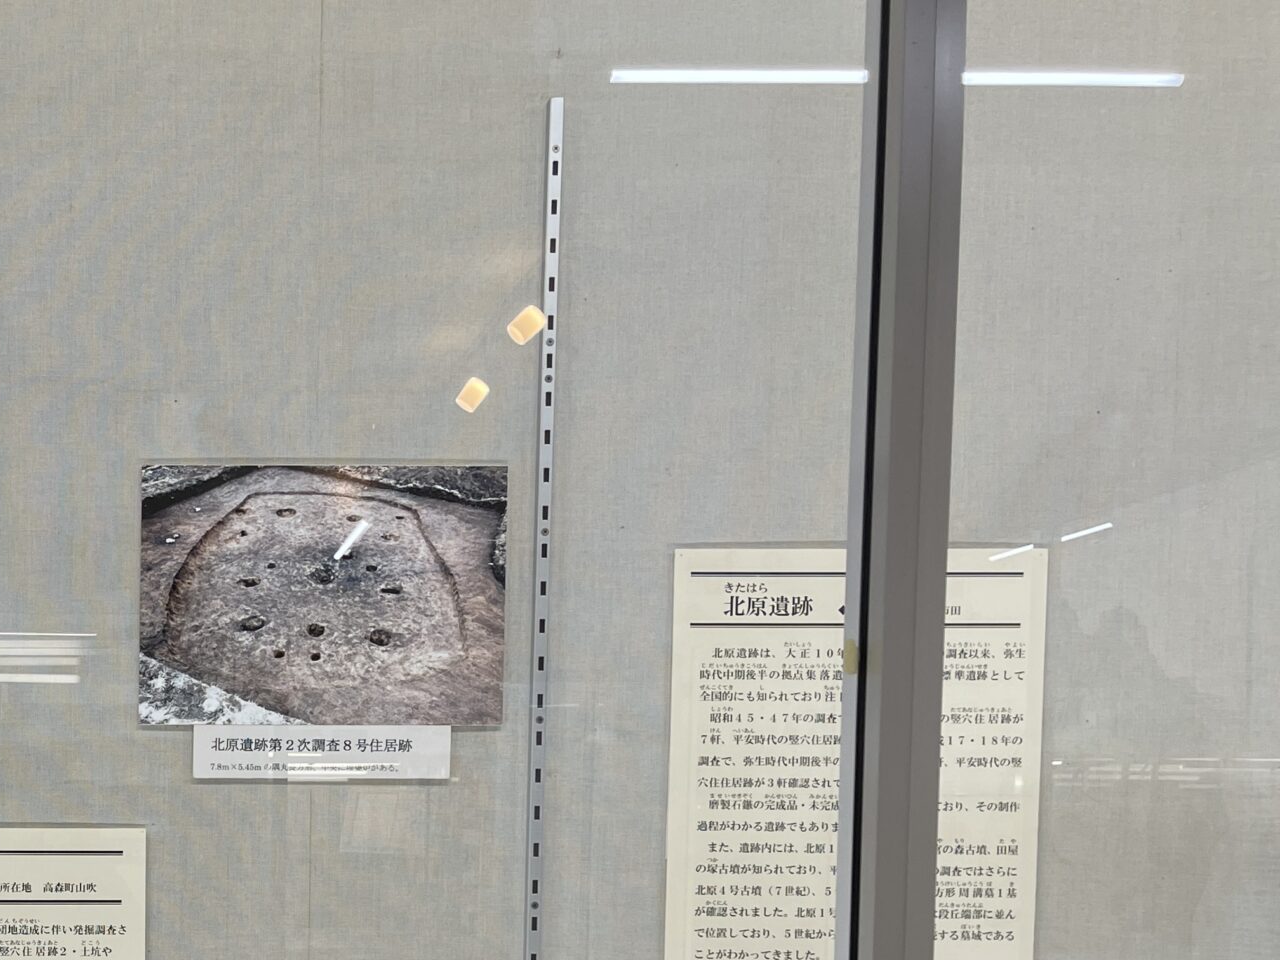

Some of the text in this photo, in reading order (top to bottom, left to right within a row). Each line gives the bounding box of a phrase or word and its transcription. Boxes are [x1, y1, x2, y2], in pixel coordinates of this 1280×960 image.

[724, 582, 768, 594] きたはら
[723, 595, 813, 617] 北原遺跡
[699, 690, 843, 703] 全国的にも知られており注
[710, 712, 842, 724] 昭和45・47年の調査
[42, 881, 97, 893] 高森町山吹
[695, 949, 821, 960] ことがわかってきました。
